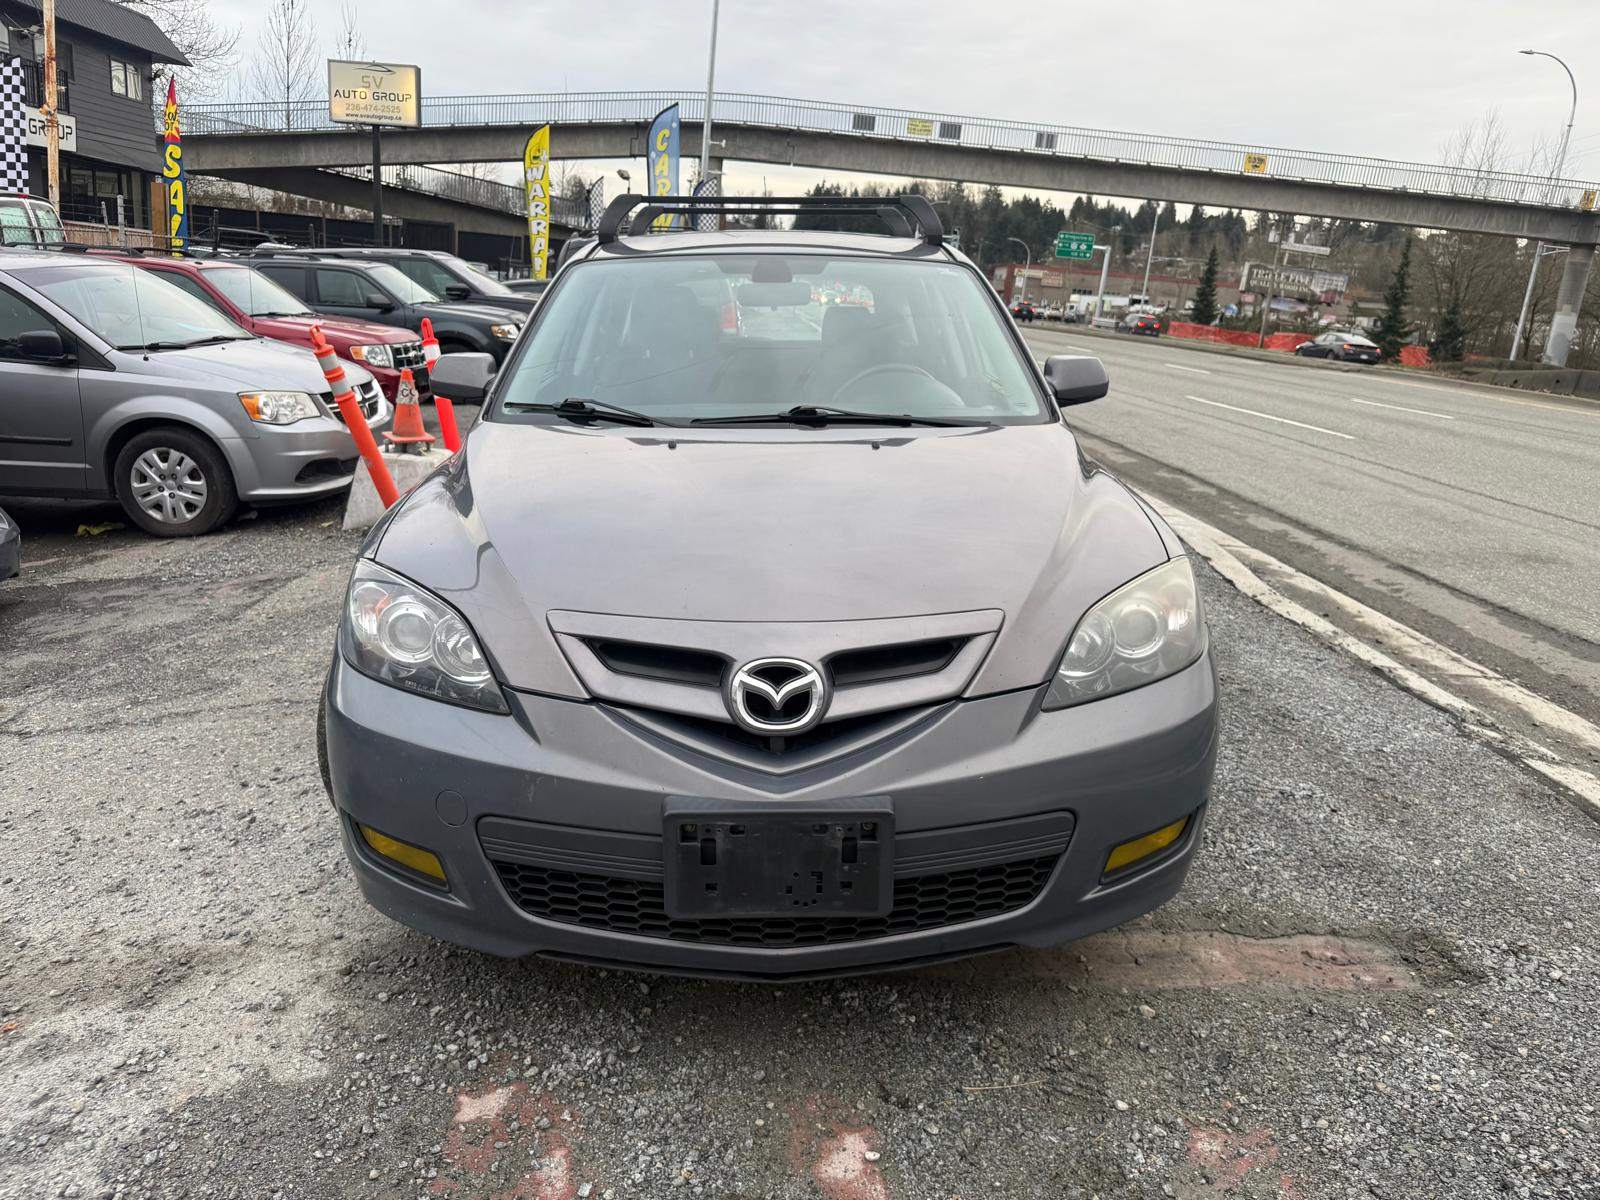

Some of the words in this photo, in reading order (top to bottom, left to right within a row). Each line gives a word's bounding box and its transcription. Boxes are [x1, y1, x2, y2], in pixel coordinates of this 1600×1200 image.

[361, 75, 383, 89] SV
[334, 89, 367, 99] AUTO
[372, 91, 412, 102] GROUP
[29, 118, 72, 140] GRUP
[1249, 279, 1278, 289] QUALIY
